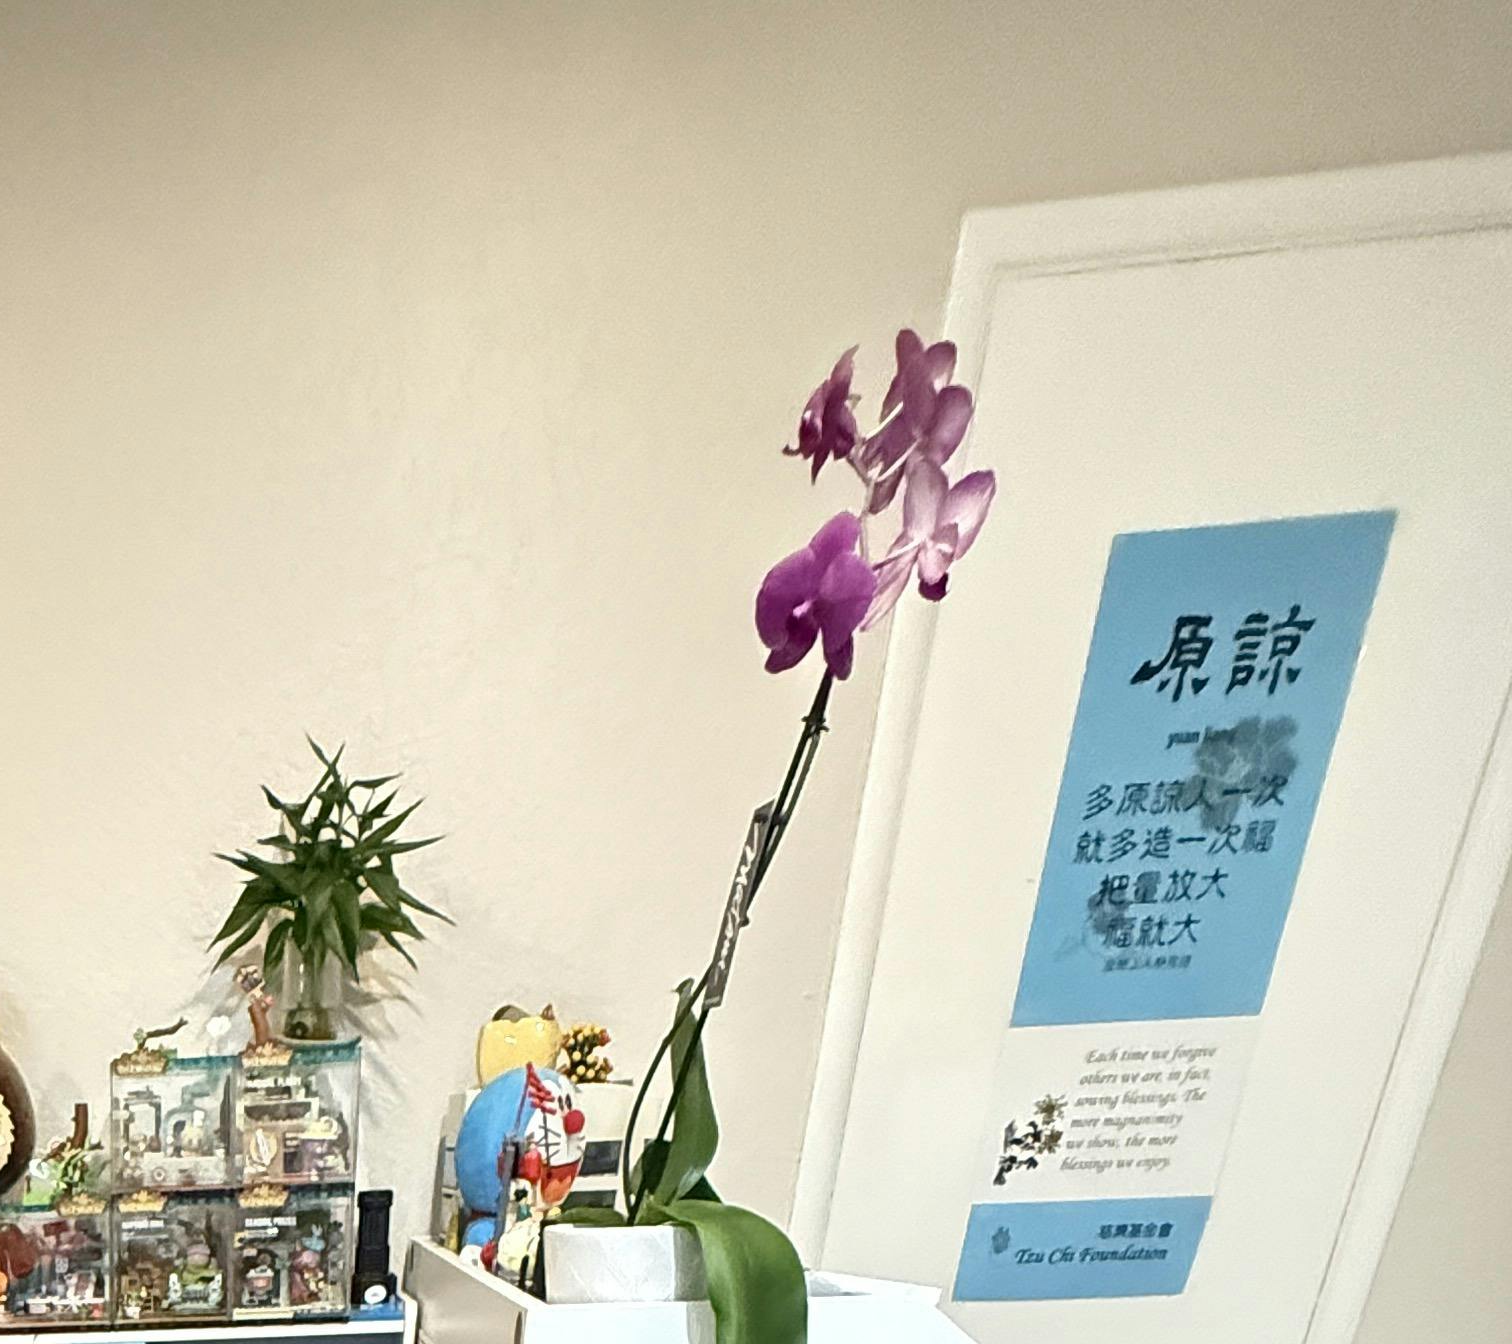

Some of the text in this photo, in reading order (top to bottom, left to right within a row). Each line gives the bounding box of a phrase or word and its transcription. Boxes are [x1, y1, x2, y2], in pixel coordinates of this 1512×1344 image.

[1130, 604, 1317, 703] 原諒
[1083, 775, 1289, 821] 多原諒人一次
[1073, 820, 1278, 864] 就多造一次福
[1086, 1047, 1118, 1063] Each
[1079, 1069, 1118, 1085] others
[1184, 1088, 1207, 1102] The
[1125, 1132, 1146, 1147] the
[1147, 1136, 1179, 1146] more
[1015, 1243, 1168, 1264] Tzu Chi Foundation
